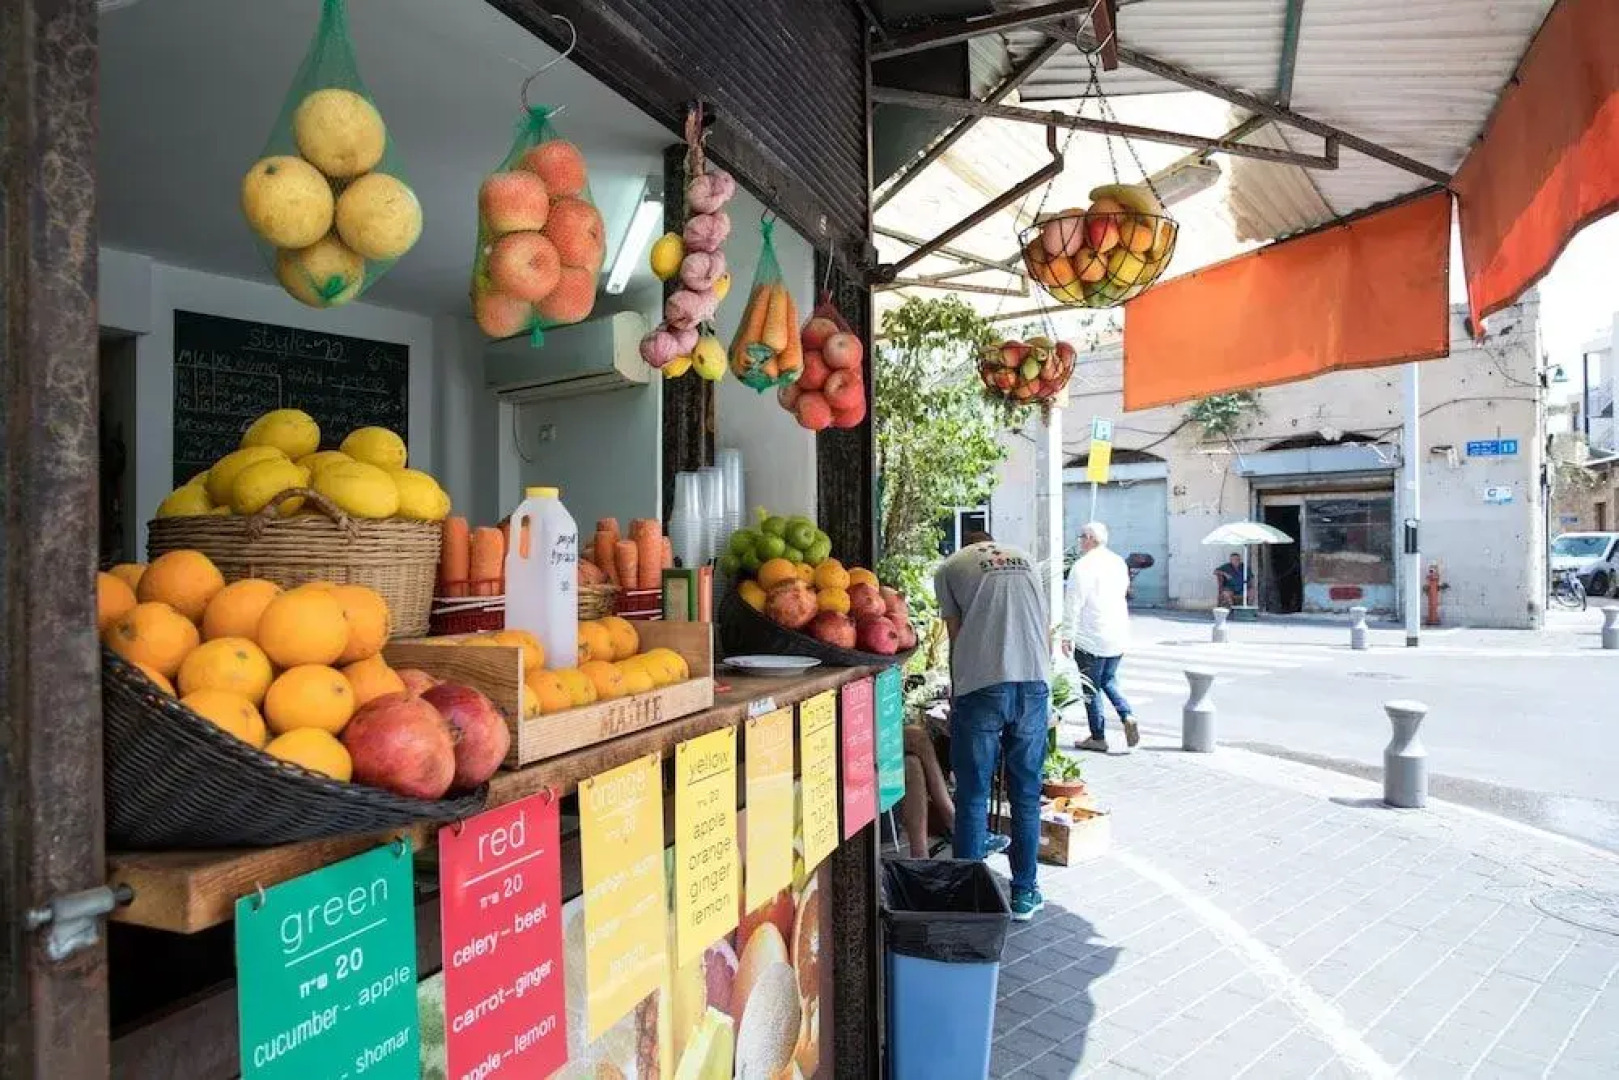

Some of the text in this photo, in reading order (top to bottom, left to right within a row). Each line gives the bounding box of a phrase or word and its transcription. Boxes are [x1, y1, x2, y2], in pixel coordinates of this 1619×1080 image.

[689, 751, 729, 782] yellow
[478, 810, 526, 863] red
[694, 812, 726, 840] apple
[689, 837, 731, 870] orange
[504, 873, 524, 898] 20
[689, 863, 731, 905] ginger
[280, 877, 389, 955] green
[692, 893, 731, 926] lemon
[452, 929, 498, 968] celery
[514, 902, 548, 934] beet
[335, 946, 364, 980] 20
[253, 1003, 339, 1069] cucumber
[358, 965, 411, 1006] apple
[514, 1013, 556, 1056] lemon
[355, 1026, 411, 1074] shomar
